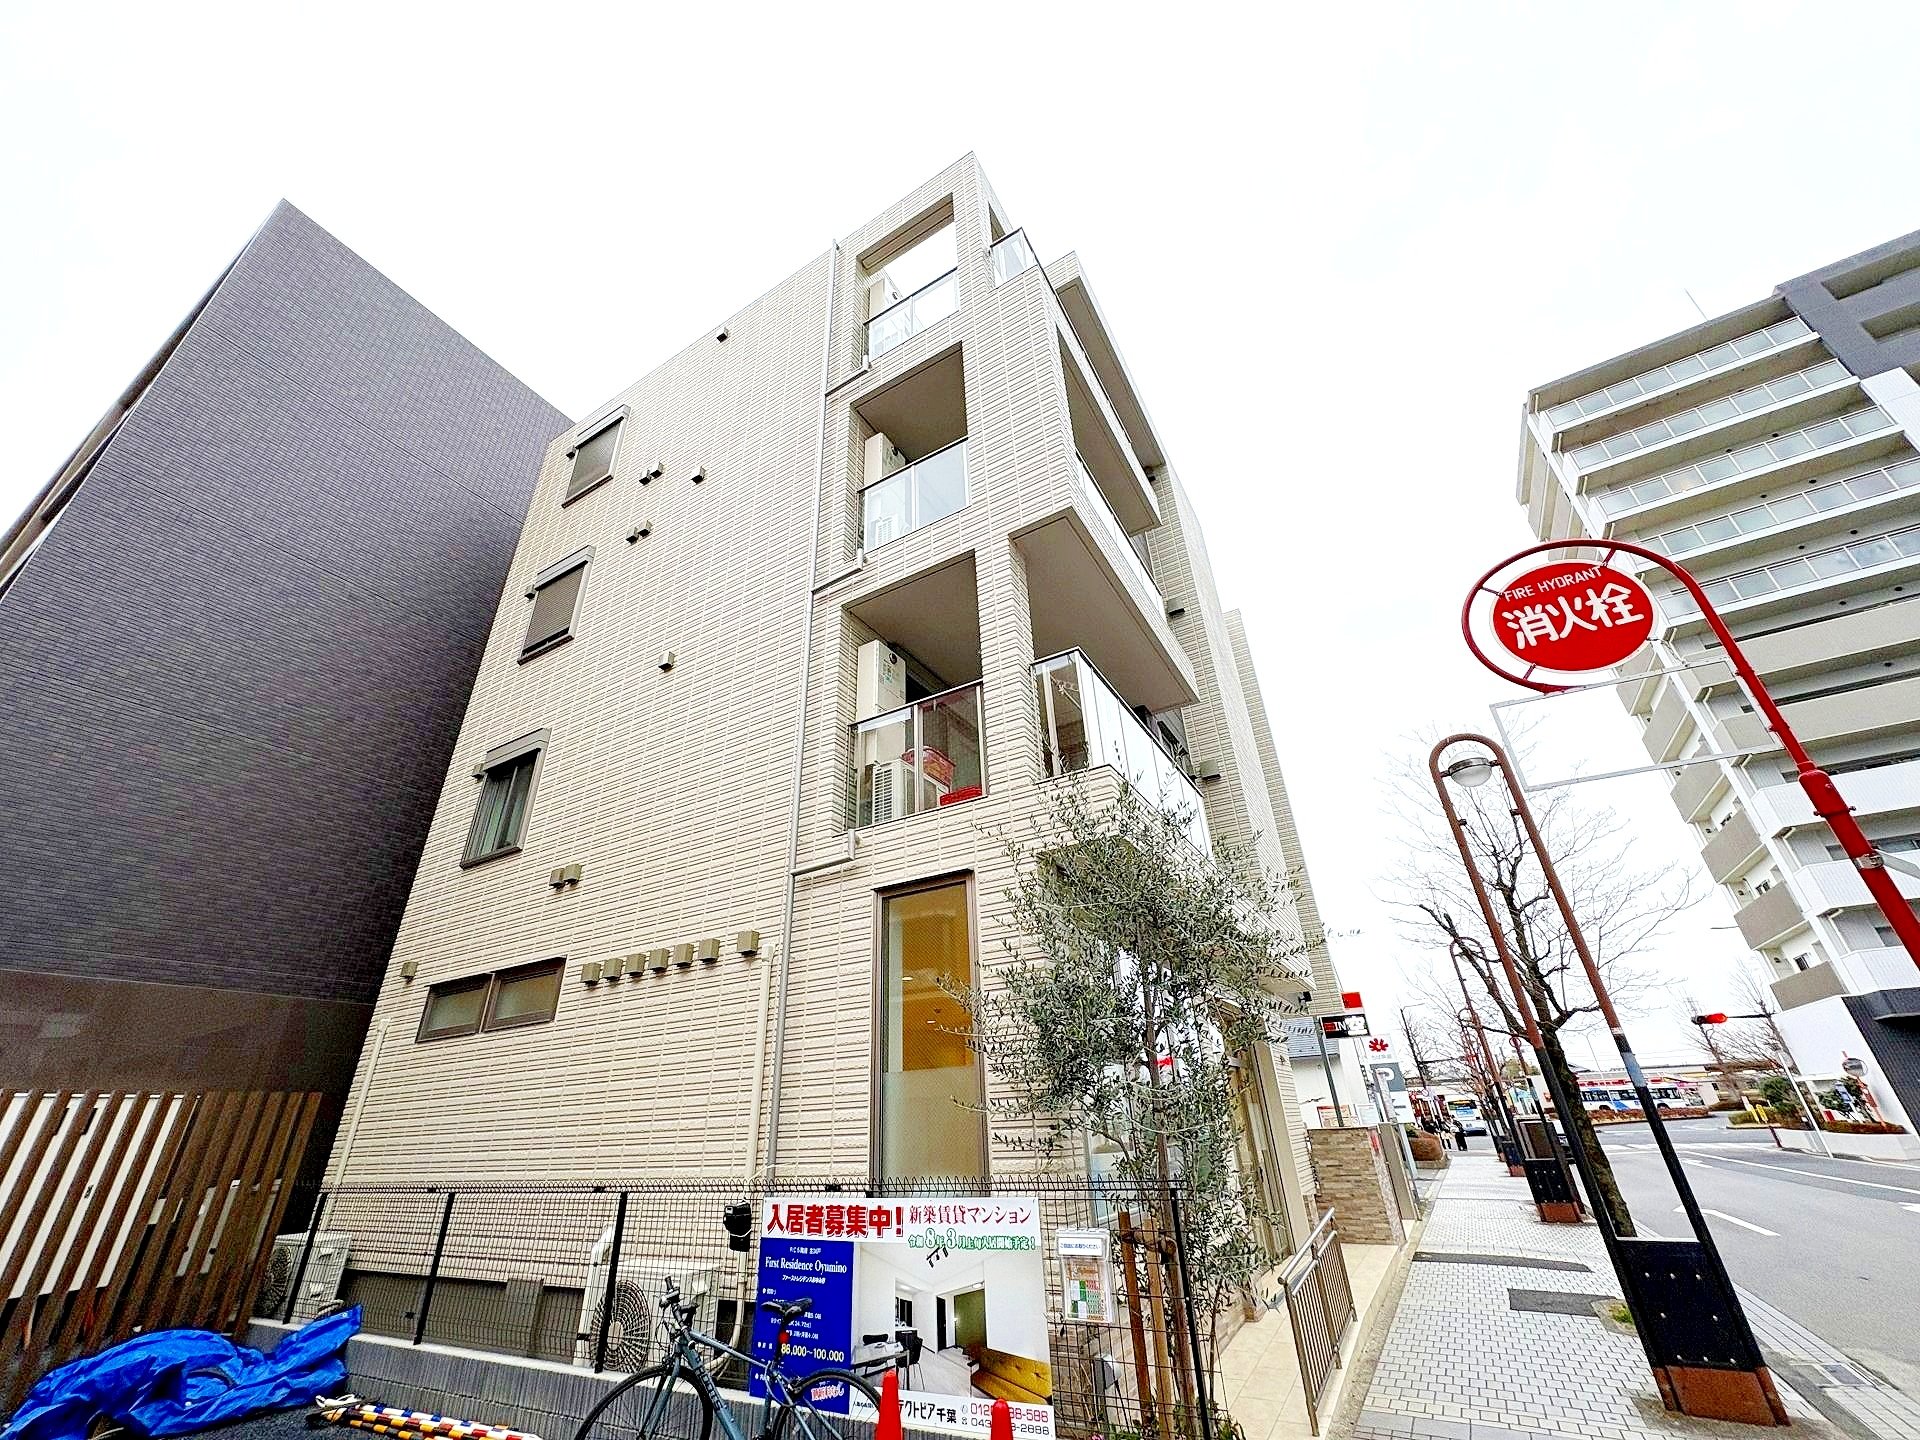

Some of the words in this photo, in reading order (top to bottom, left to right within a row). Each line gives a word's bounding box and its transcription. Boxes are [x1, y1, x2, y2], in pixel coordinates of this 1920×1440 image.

[1504, 585, 1535, 602] FIRE
[1537, 566, 1603, 593] HYDRANT
[1501, 582, 1645, 650] 消火栓
[766, 1203, 904, 1237] 入居者募集中!
[909, 1204, 1032, 1225] 新築賃貸マンション
[765, 1256, 779, 1269] First
[780, 1257, 813, 1271] Residence
[814, 1259, 848, 1276] Oyumino
